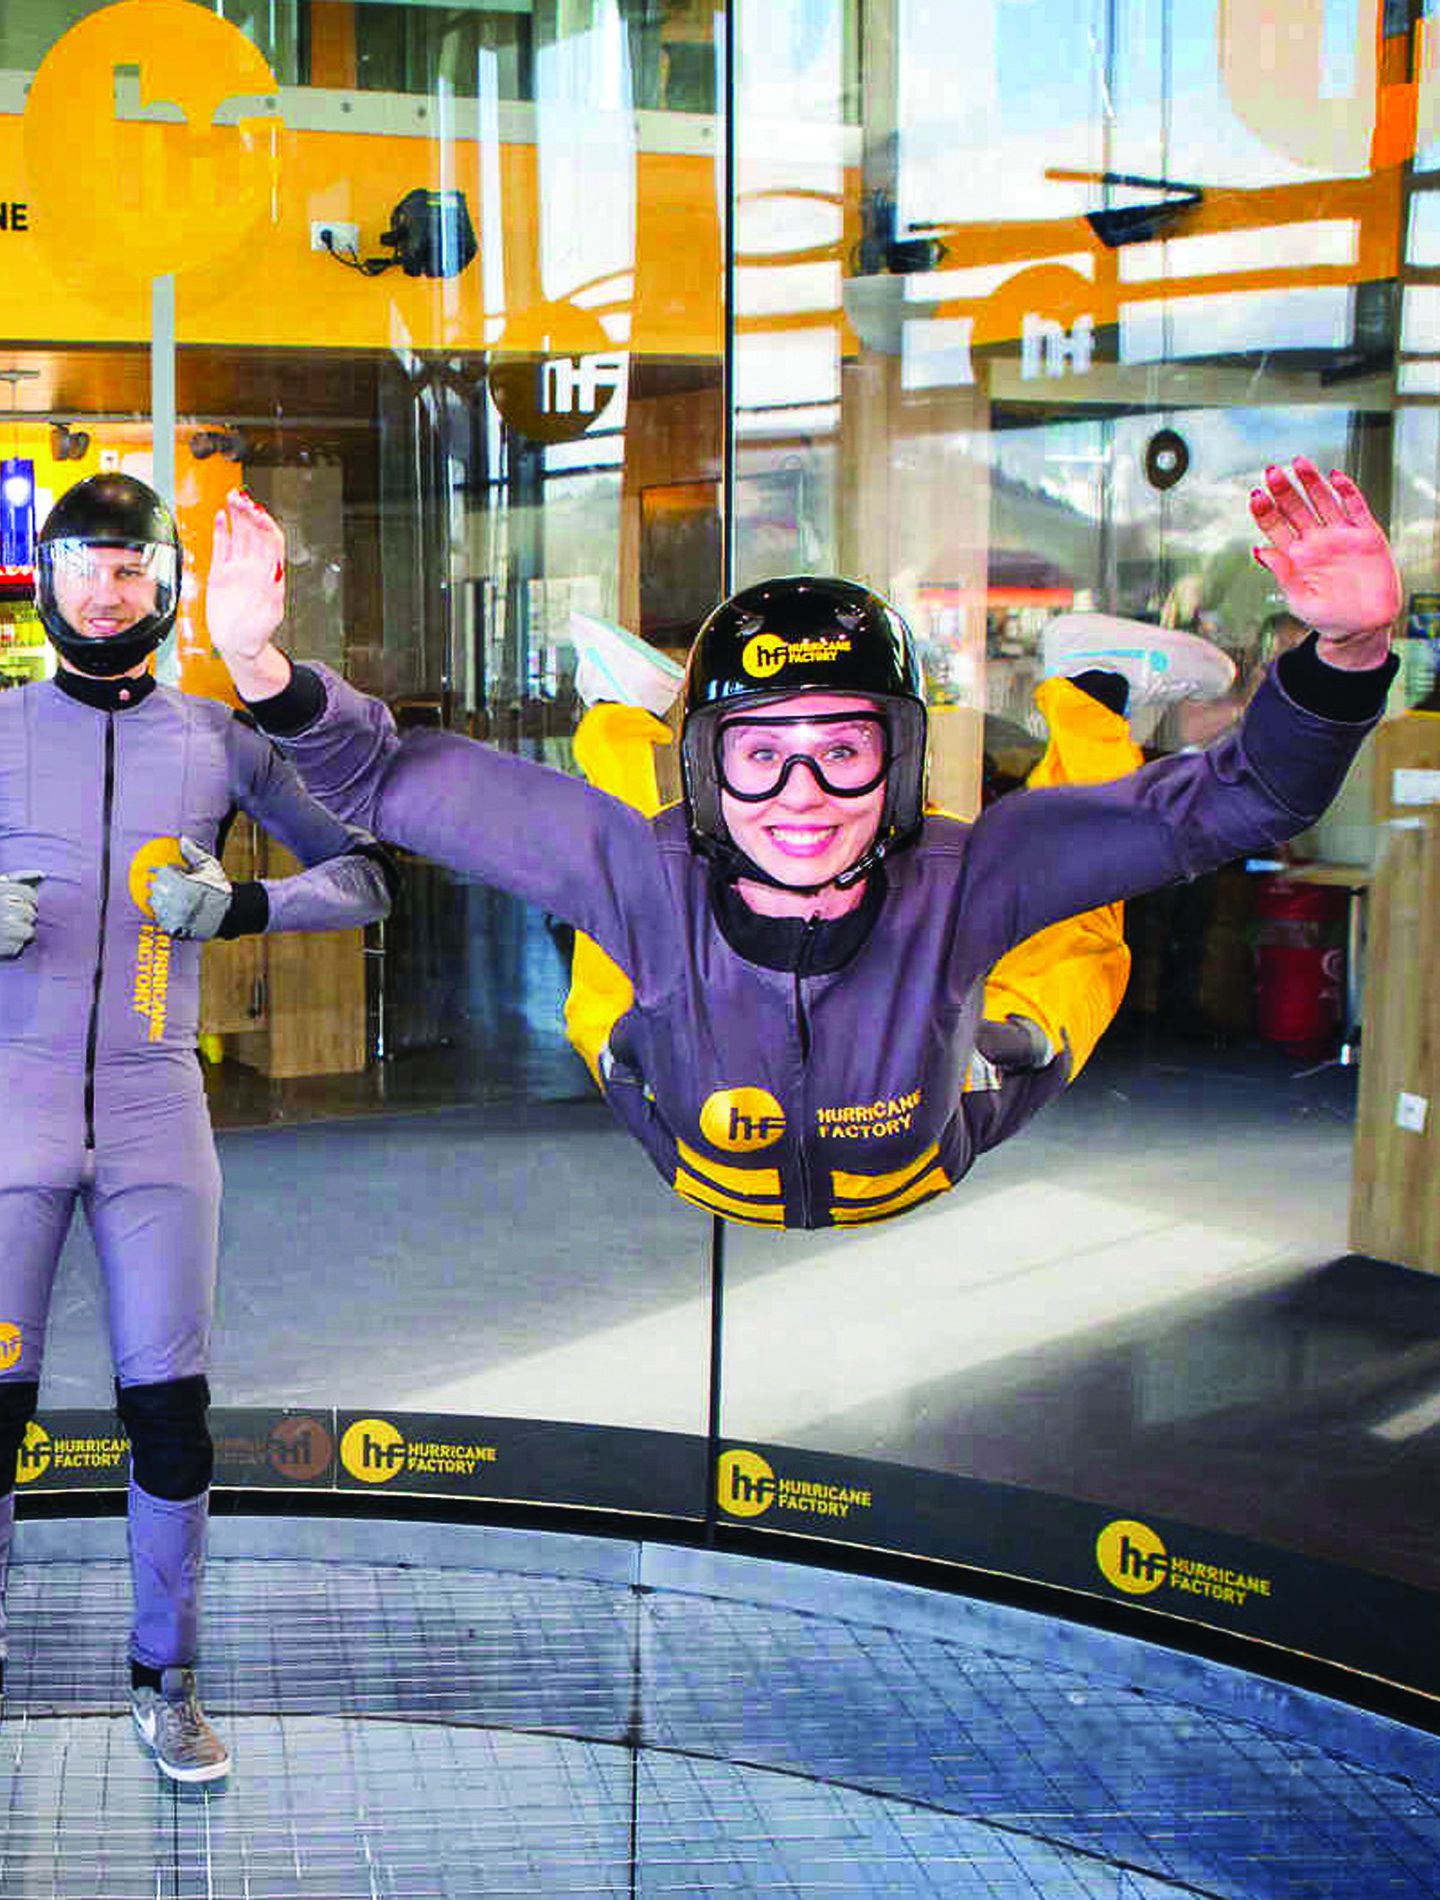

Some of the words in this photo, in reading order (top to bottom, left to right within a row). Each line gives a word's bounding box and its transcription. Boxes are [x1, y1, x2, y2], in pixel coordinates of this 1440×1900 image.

[817, 1088, 922, 1124] HURRICANE
[728, 1107, 787, 1141] hf
[818, 1114, 912, 1138] FACTORY
[53, 1453, 121, 1468] FACTORY
[363, 1434, 407, 1468] hf
[408, 1442, 497, 1462] HURRICANE
[408, 1457, 475, 1475] FACTORY
[732, 1464, 776, 1503] hf
[778, 1478, 872, 1507] HURRICANE
[778, 1493, 850, 1518] FACTORY
[1120, 1535, 1168, 1582] hf
[1171, 1556, 1272, 1597] HURRICANE
[1171, 1572, 1247, 1606] FACTORY
